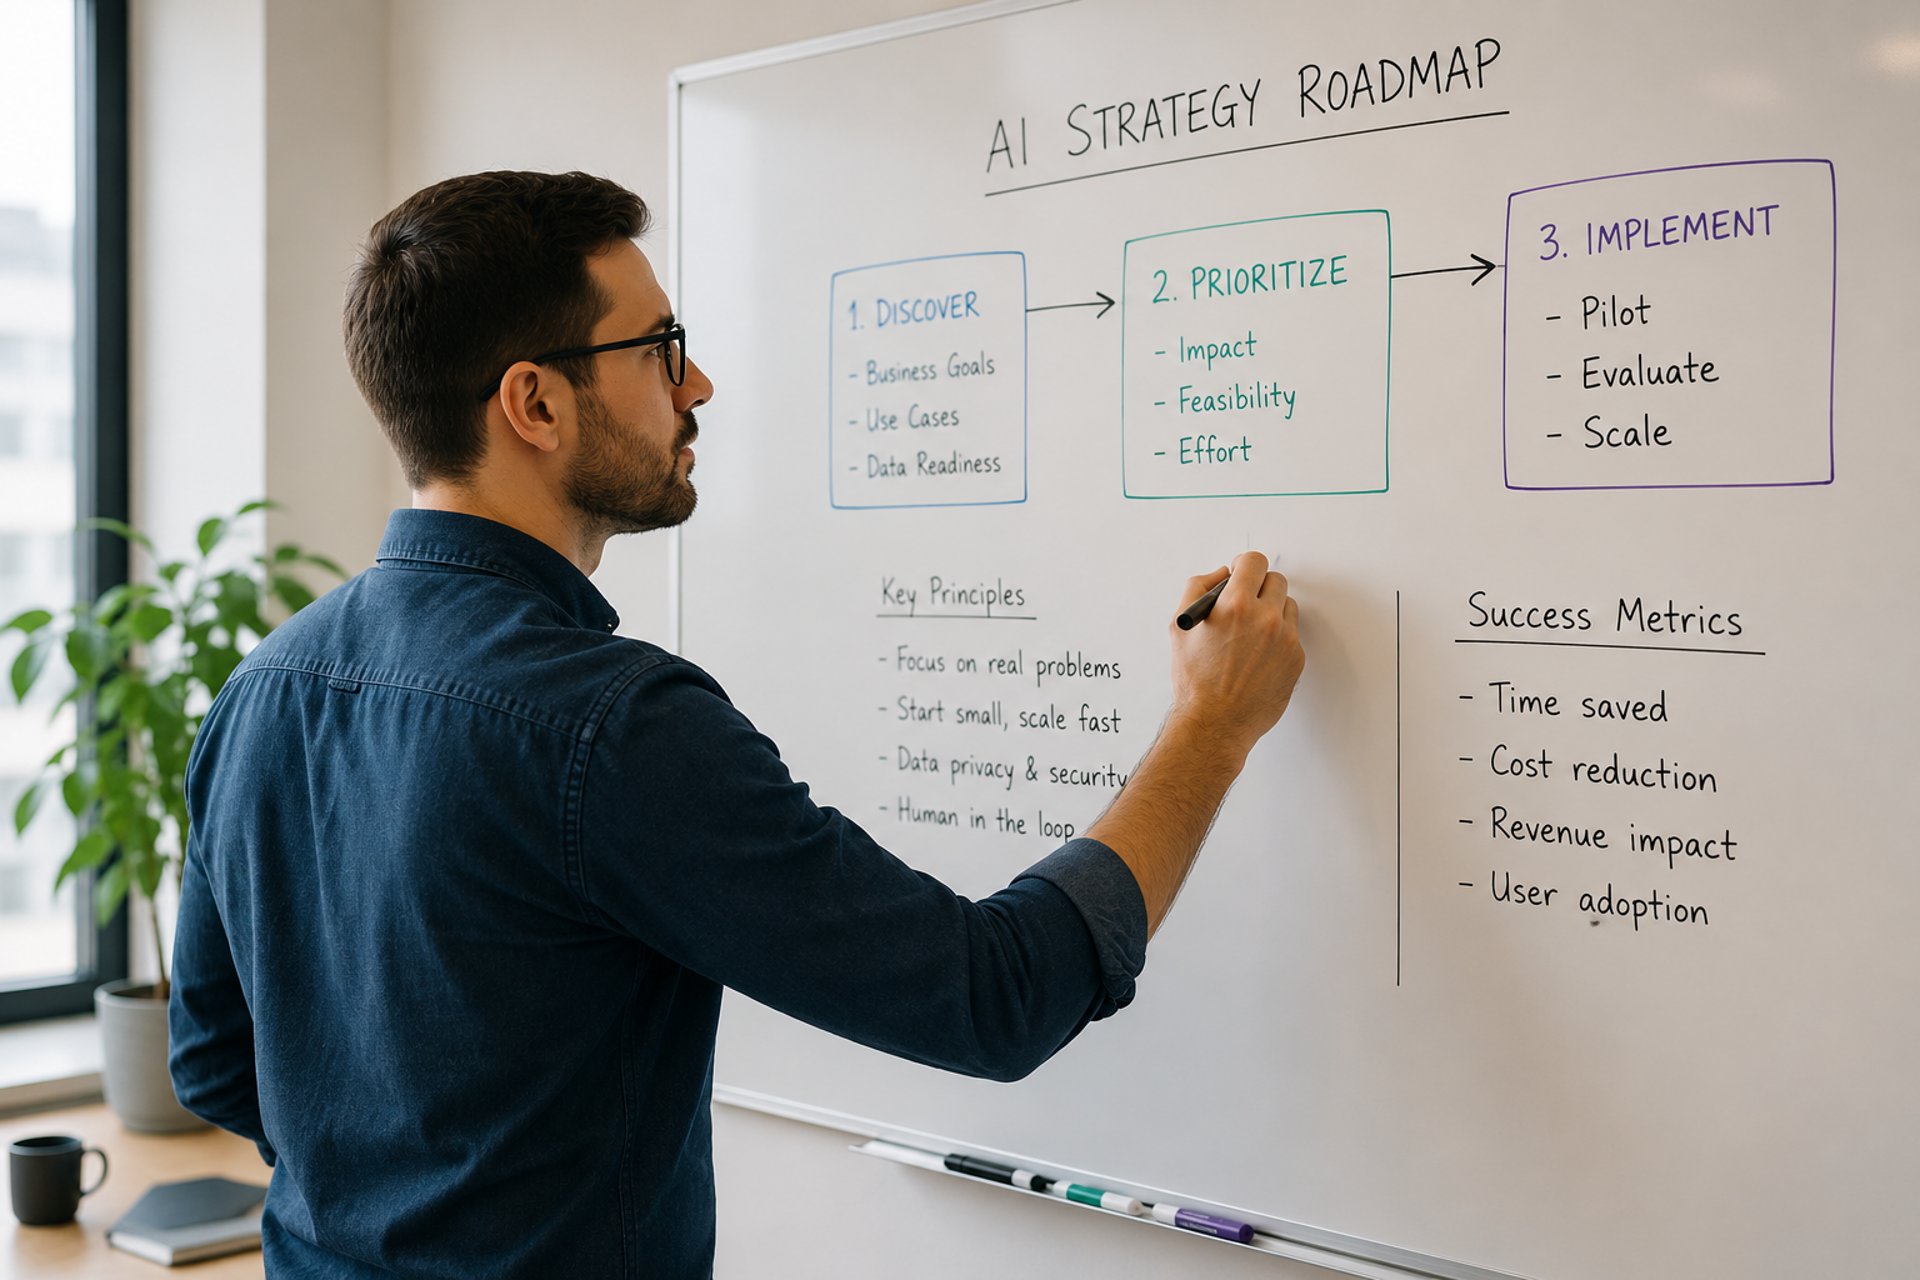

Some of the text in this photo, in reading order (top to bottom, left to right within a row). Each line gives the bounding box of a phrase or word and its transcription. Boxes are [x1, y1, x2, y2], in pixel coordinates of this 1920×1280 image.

[986, 37, 1503, 174] AI STRATEGY ROADMAP
[1539, 204, 1780, 261] 3. IMPLEMENT
[1151, 254, 1348, 305] 2. PRIORITIZE
[848, 289, 981, 331] 1. DISCOVER
[1581, 294, 1652, 330] Pilot
[866, 350, 996, 387] Business Goals
[1179, 330, 1258, 372] Impact
[1582, 351, 1720, 390] Evaluate
[866, 403, 960, 433] Use Cases
[1179, 380, 1296, 421] Feasibility
[1179, 434, 1253, 465] Effort
[1584, 412, 1673, 449] Scale
[867, 449, 1002, 480] Data Readiness
[882, 575, 1026, 615] Key Principles
[1468, 590, 1743, 636] Success Metrics
[896, 644, 1122, 688] Focus on real problems
[897, 695, 1122, 734] Start small, scale fast
[1488, 681, 1669, 723] Time saved
[897, 744, 940, 773] Data
[950, 754, 1015, 792] privacy
[1025, 754, 1038, 782] &
[1490, 743, 1717, 793] Cost reduction
[897, 796, 1077, 842] Human in the loop
[1491, 805, 1738, 870] Revenue impact
[1491, 870, 1709, 932] User adoption
